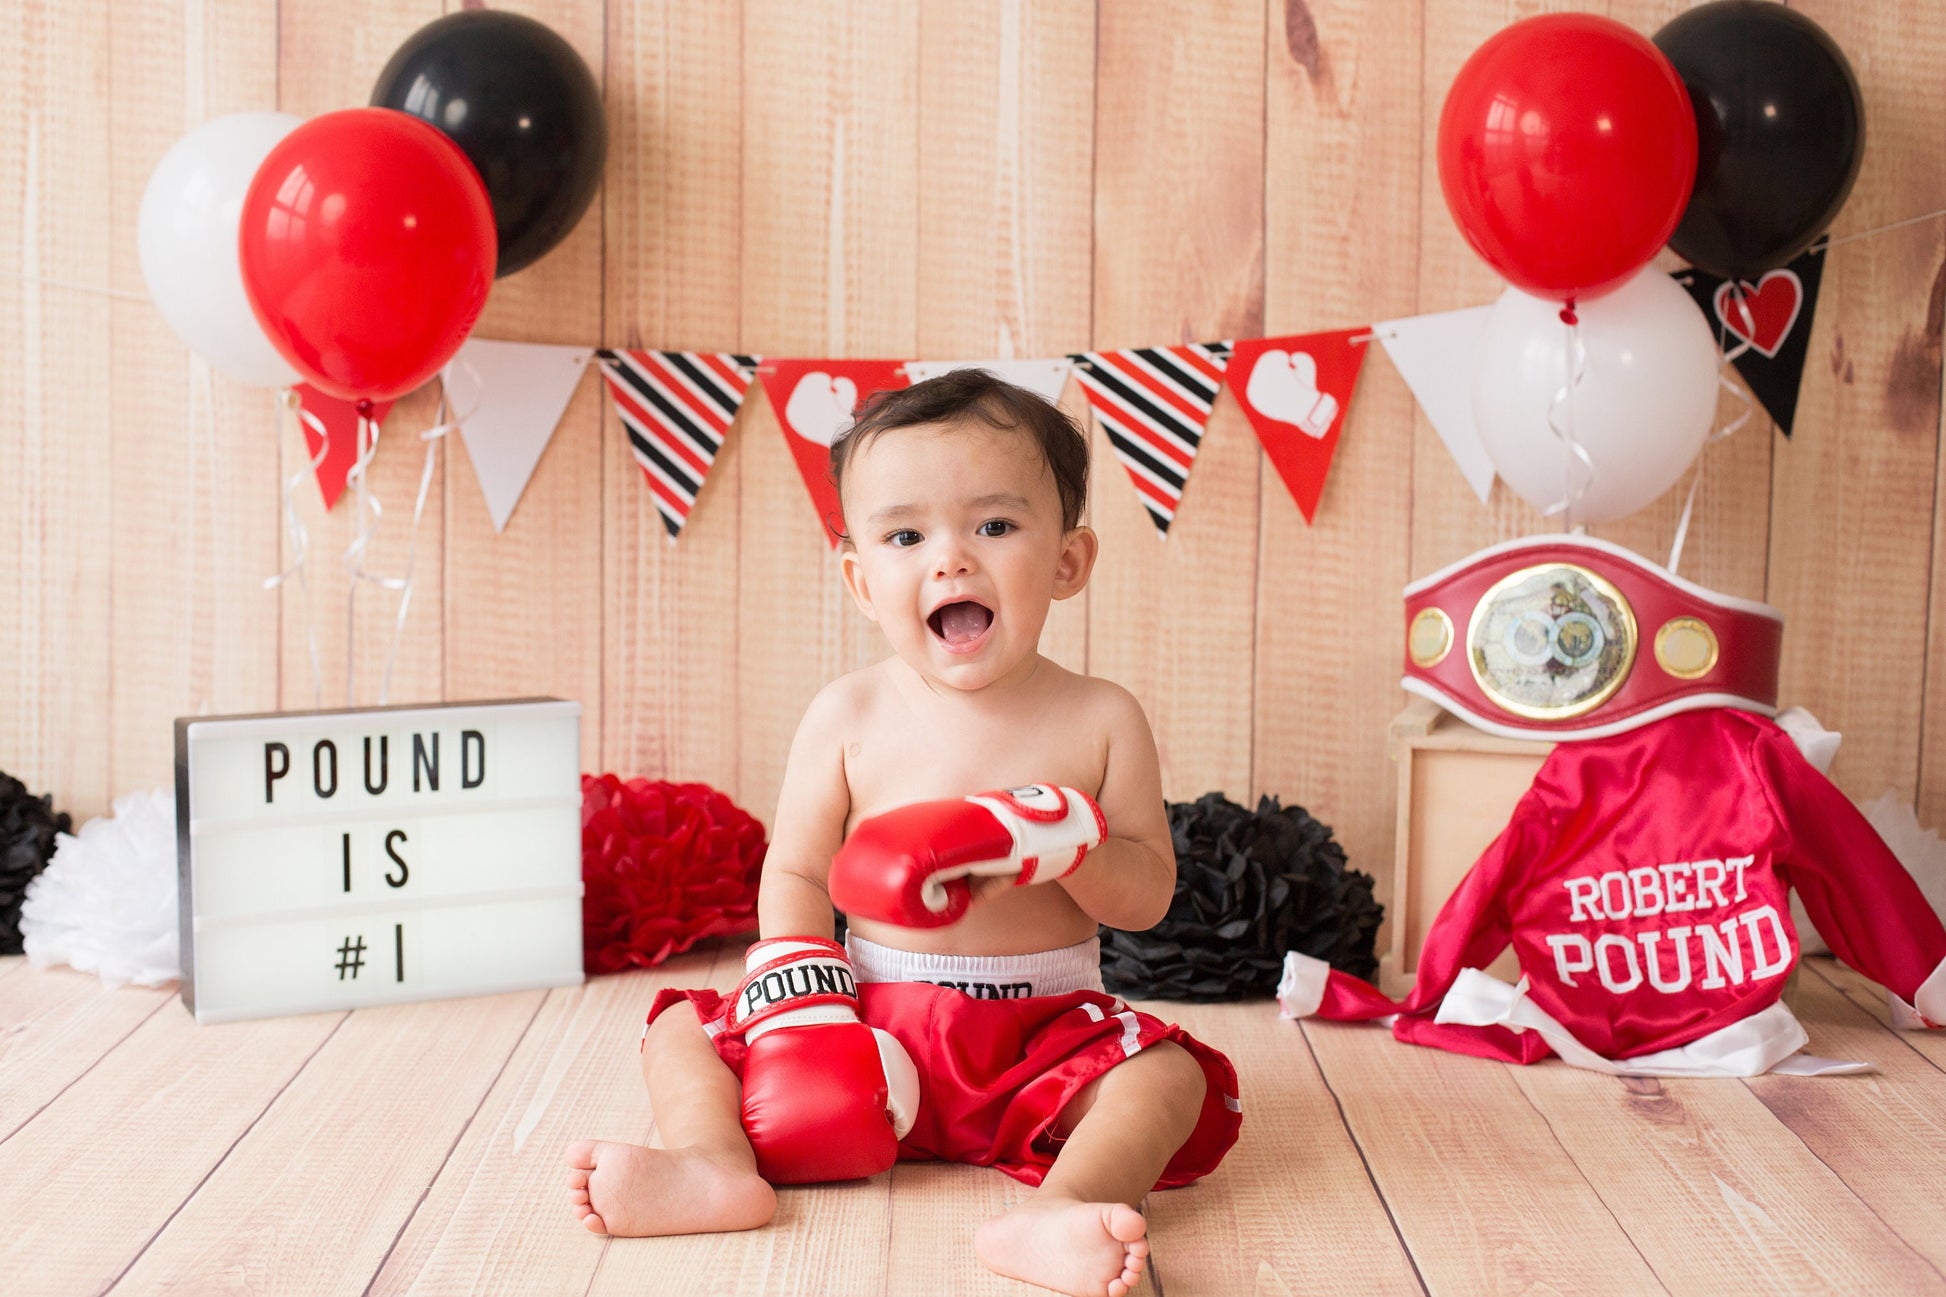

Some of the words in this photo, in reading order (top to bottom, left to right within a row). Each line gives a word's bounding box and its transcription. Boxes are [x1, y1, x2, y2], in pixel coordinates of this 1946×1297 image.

[265, 730, 486, 803] POUND
[342, 829, 410, 892] IS
[1563, 854, 1755, 922] ROBERT
[1545, 904, 1792, 994] POUND
[745, 964, 857, 1016] POUND
